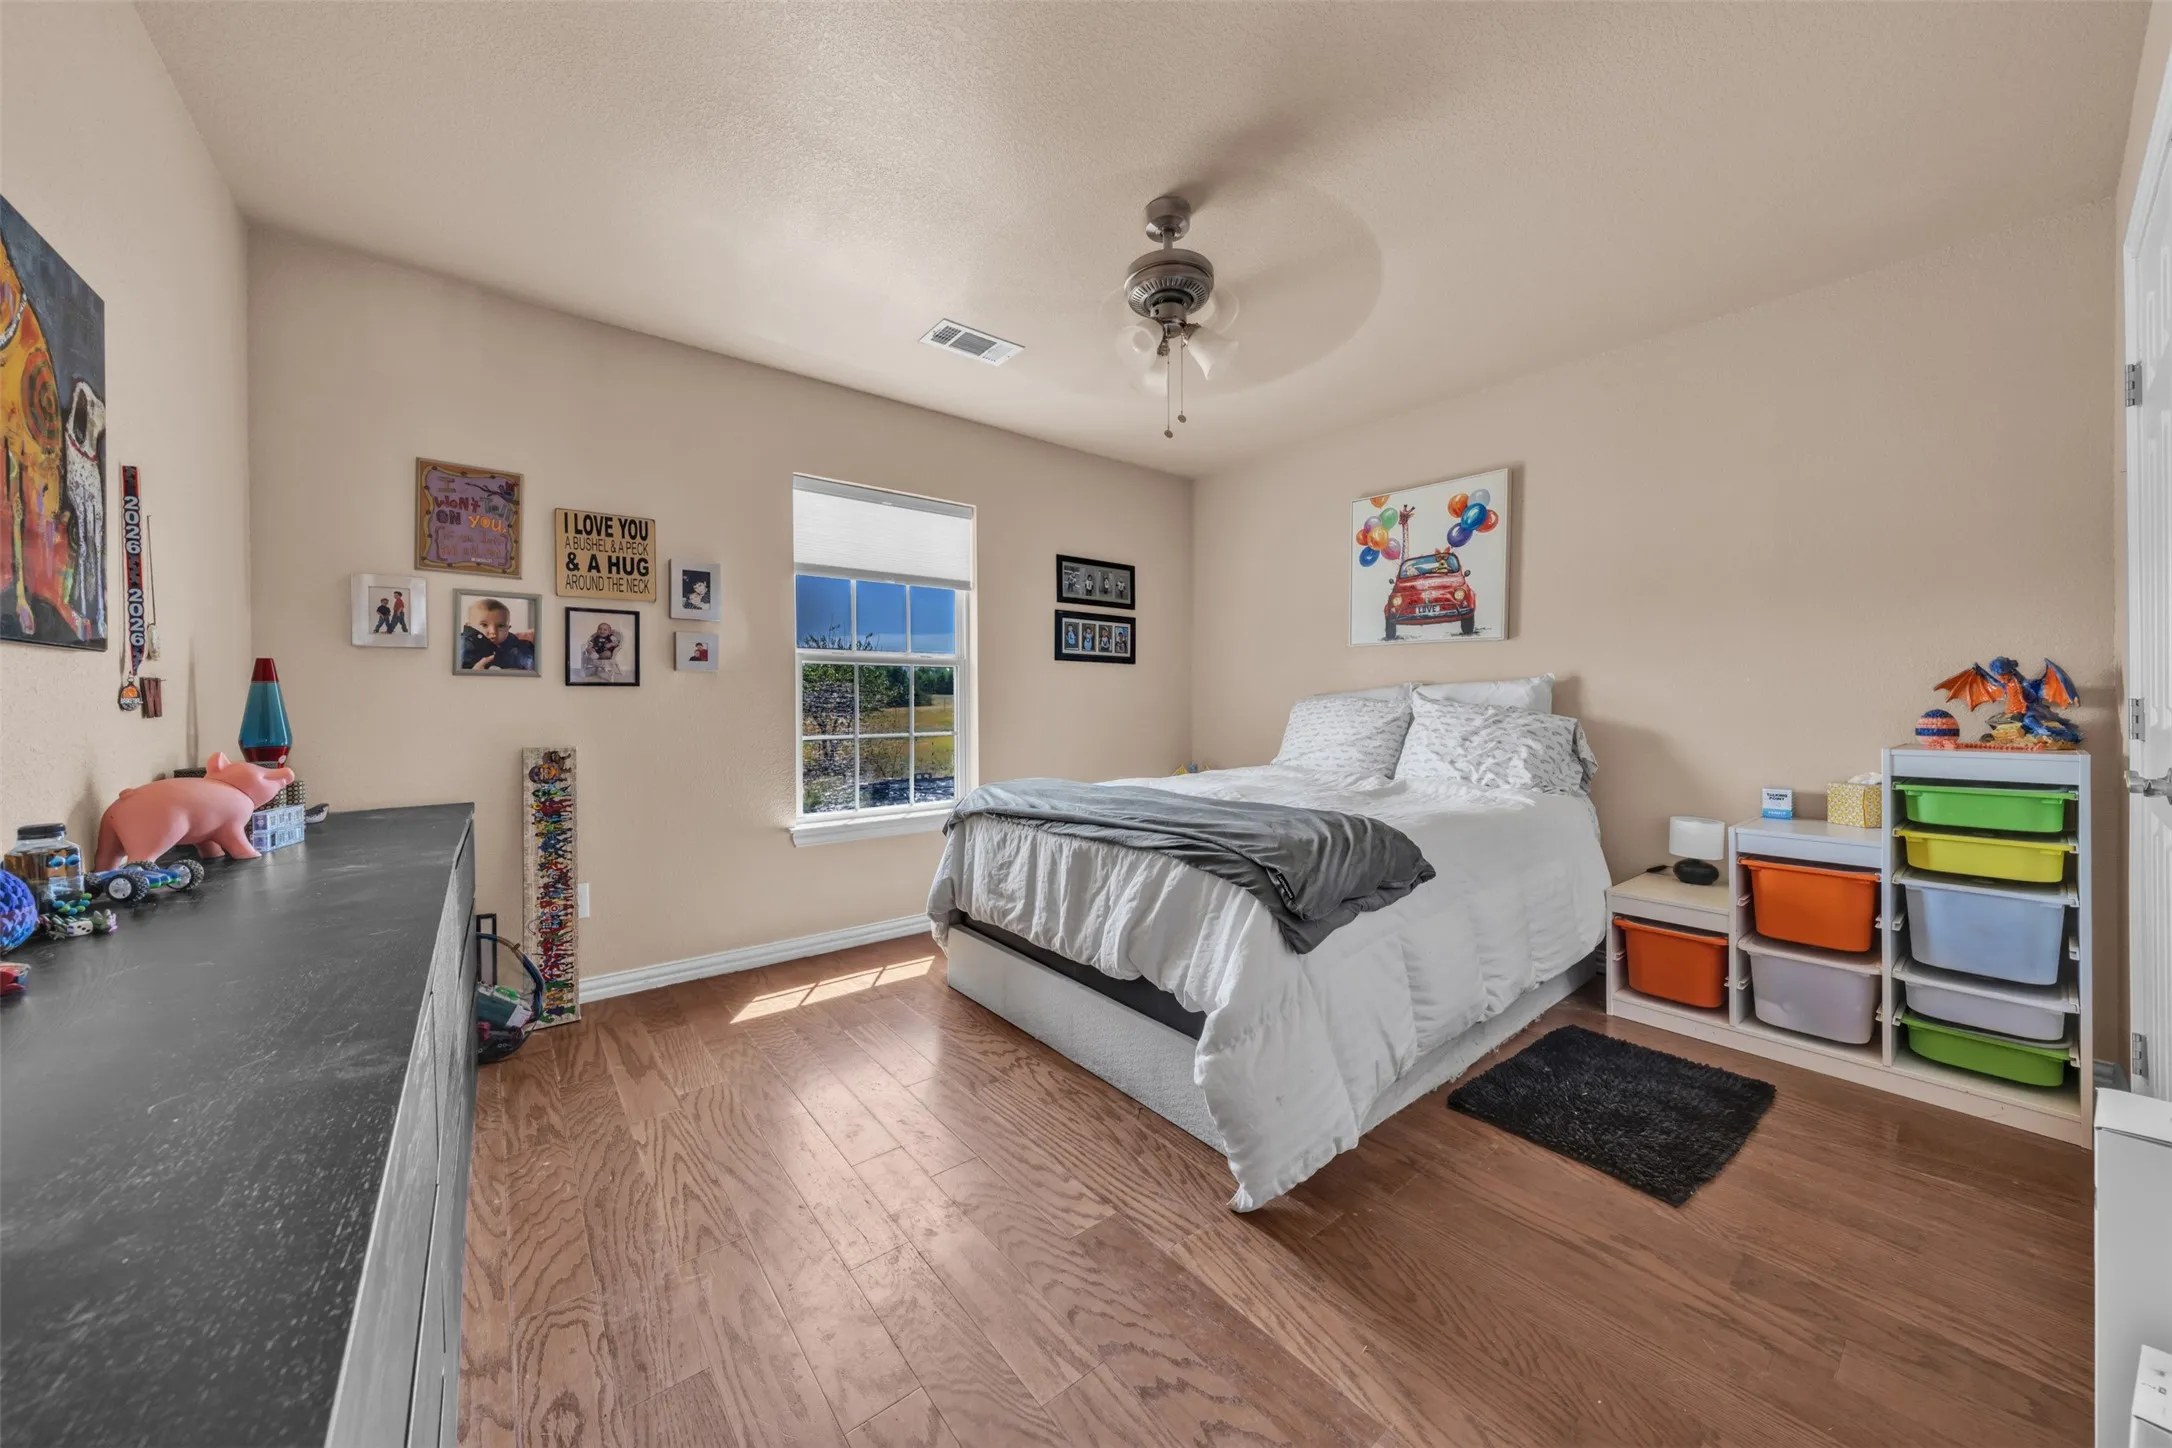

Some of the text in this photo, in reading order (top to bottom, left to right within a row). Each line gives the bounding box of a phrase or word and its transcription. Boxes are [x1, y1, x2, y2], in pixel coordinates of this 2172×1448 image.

[123, 495, 142, 555] 2026
[564, 511, 649, 542] I LOVE YOU
[564, 535, 649, 557] A BUSHEL & A PECK
[565, 551, 650, 577] & A HUG
[565, 573, 651, 594] AROUND THE NECK
[127, 588, 146, 647] 2026
